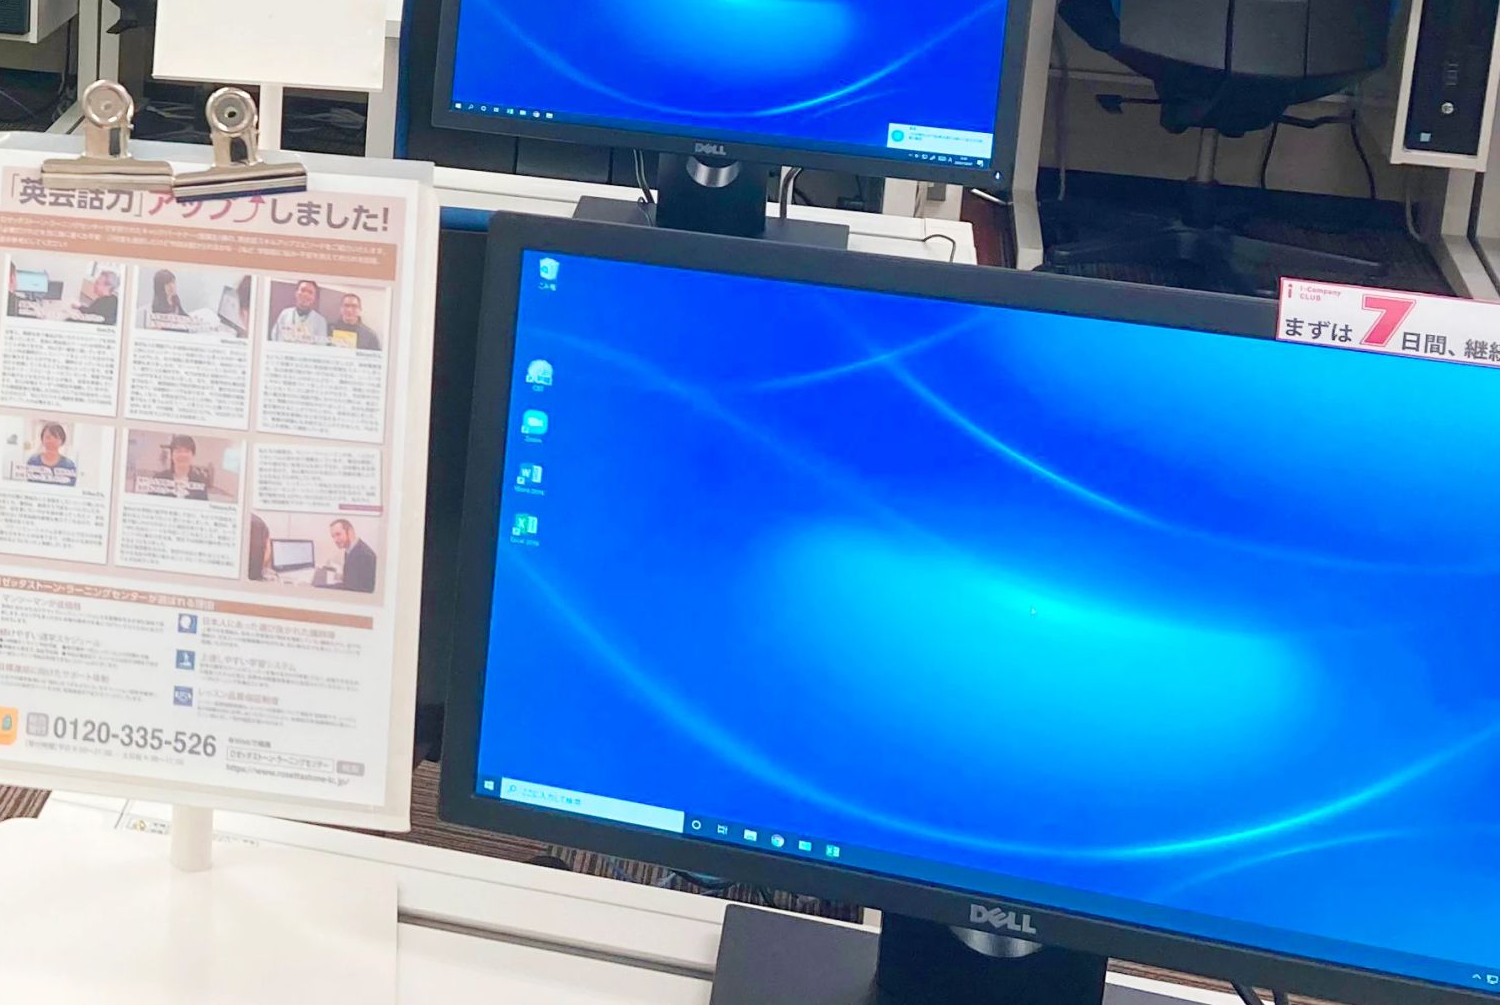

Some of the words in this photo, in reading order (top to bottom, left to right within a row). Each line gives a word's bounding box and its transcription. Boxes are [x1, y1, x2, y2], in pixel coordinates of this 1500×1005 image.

[694, 142, 726, 156] DELL
[53, 716, 217, 758] 0120-335-526
[969, 903, 1037, 934] DELL
